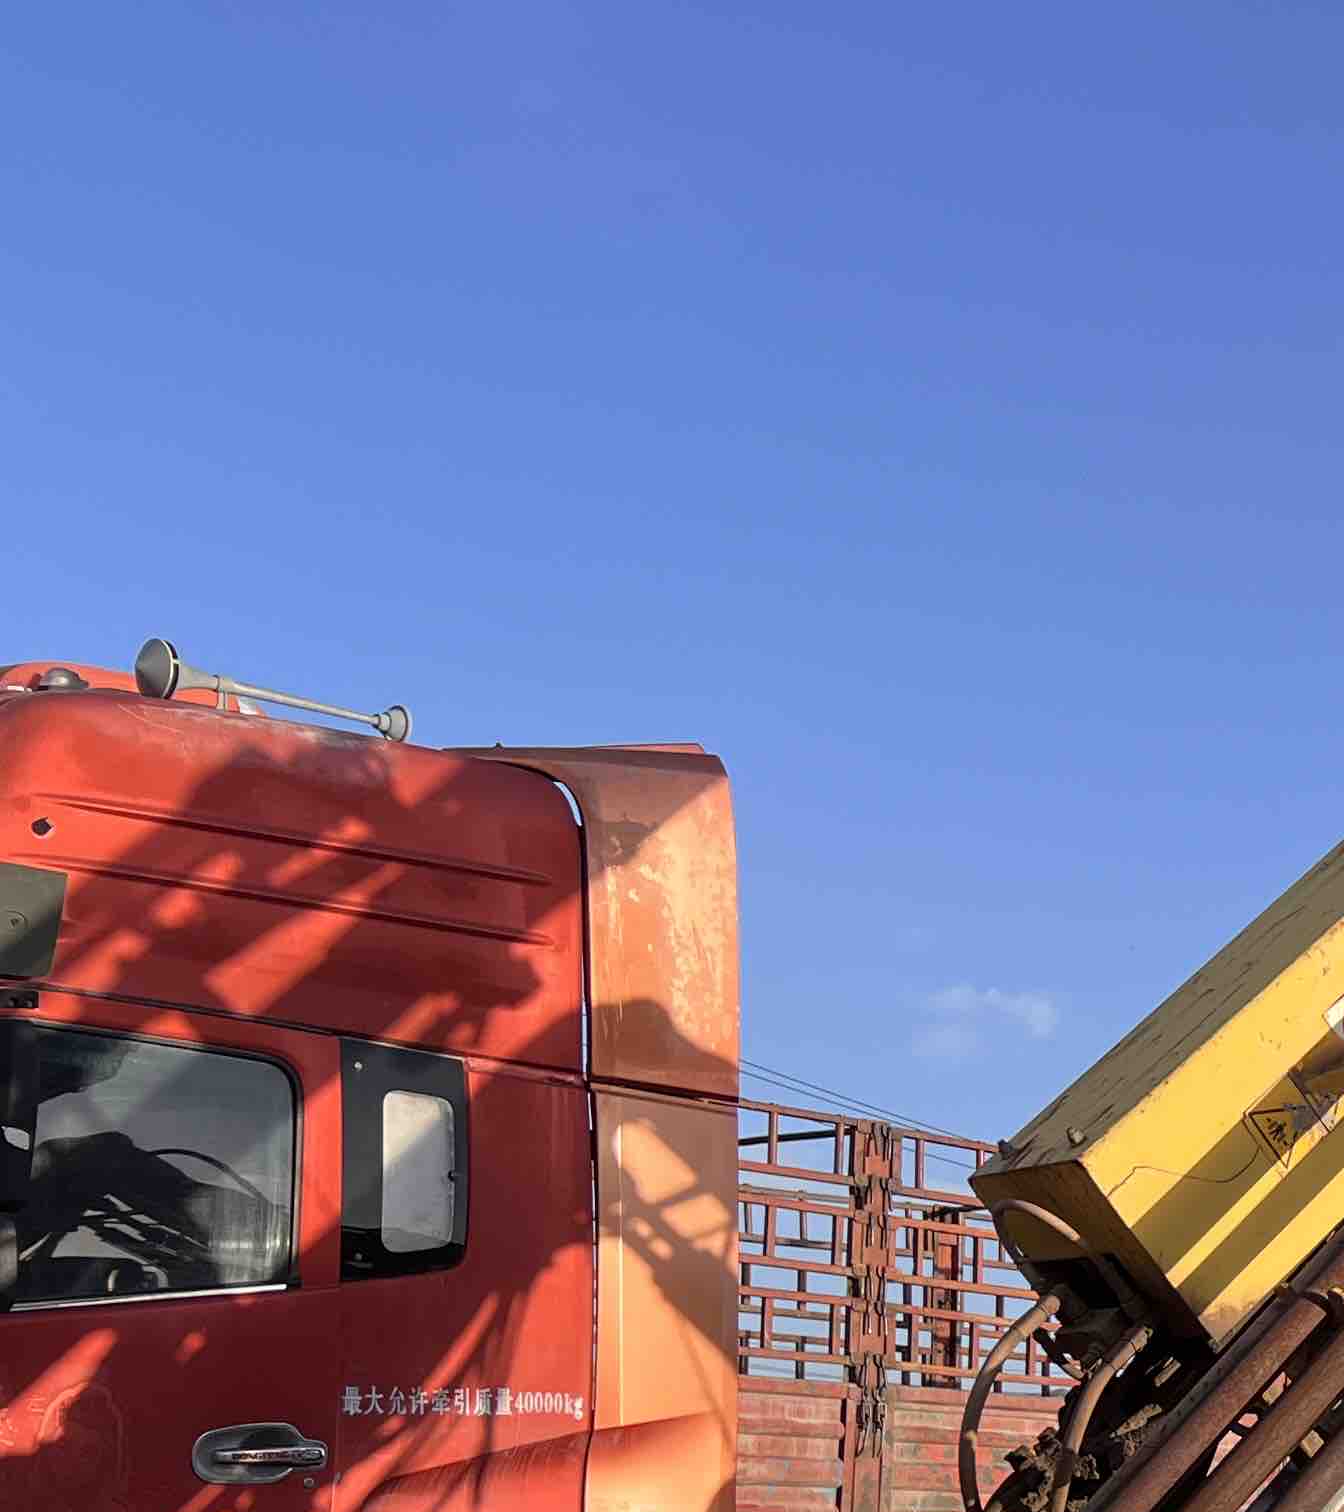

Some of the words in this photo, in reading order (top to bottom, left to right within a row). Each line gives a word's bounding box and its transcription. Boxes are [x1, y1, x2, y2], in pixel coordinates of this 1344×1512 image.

[342, 1385, 584, 1420] 最大允许牵引质量40000kg
